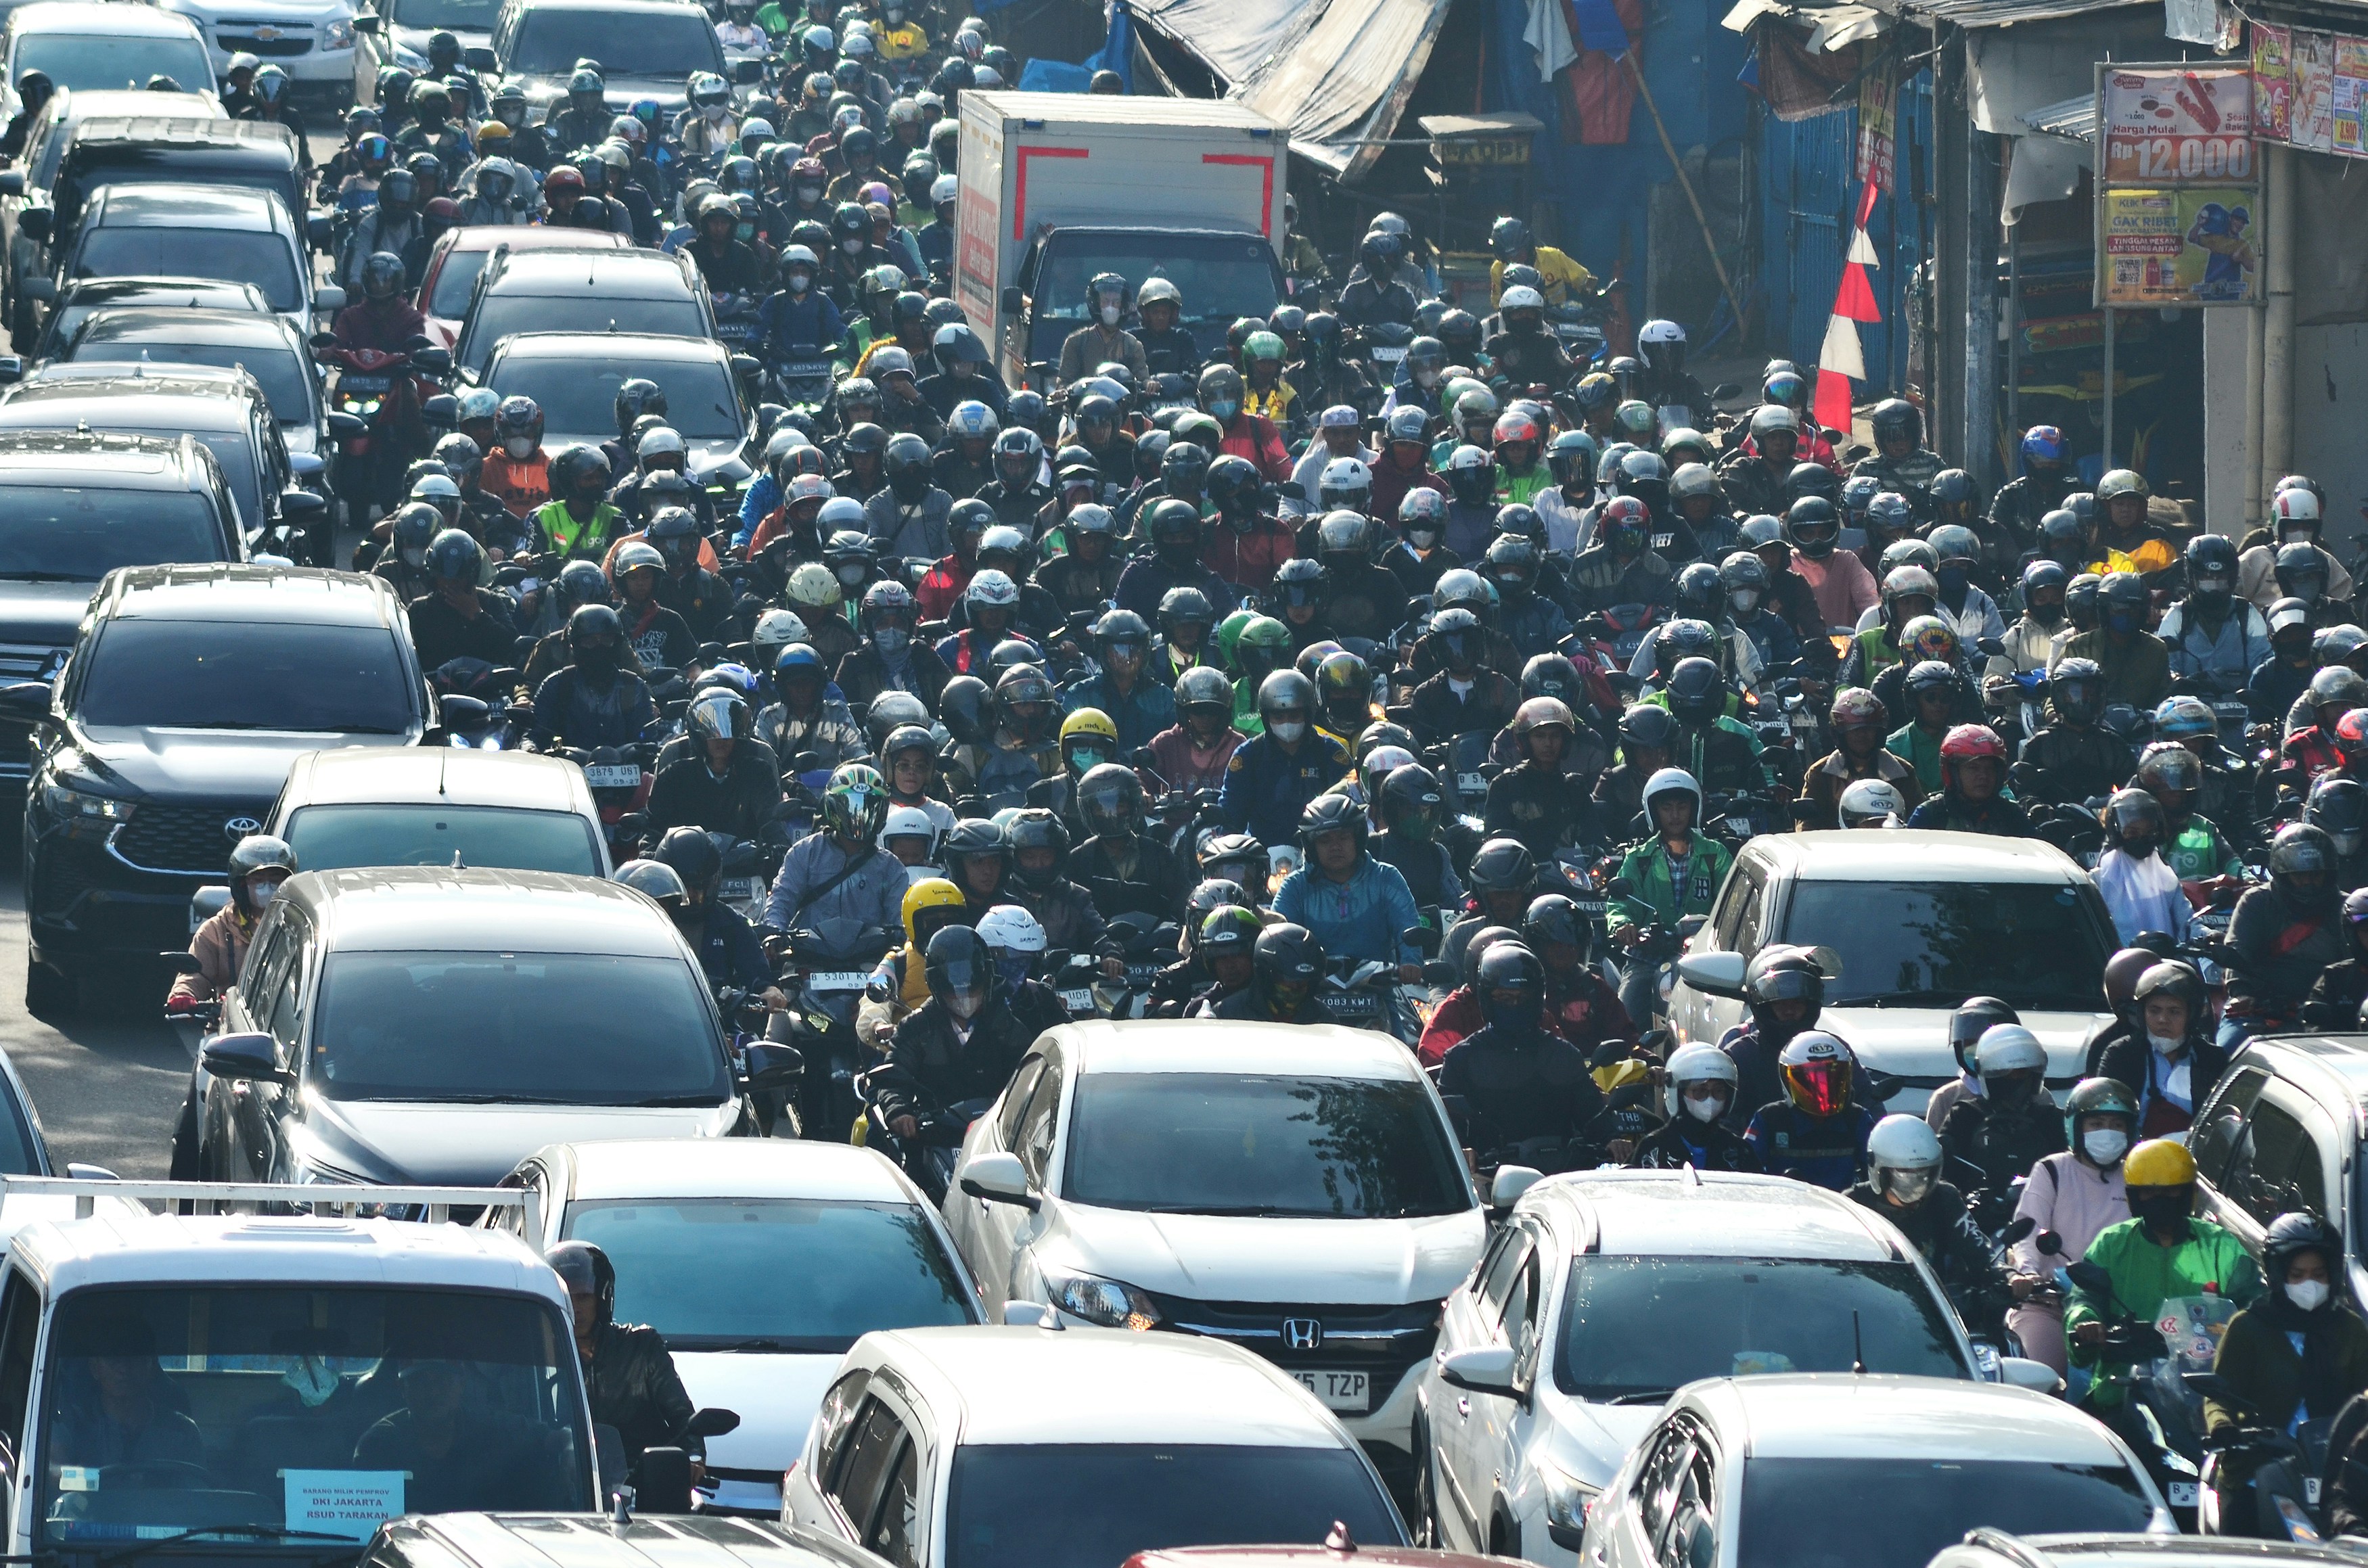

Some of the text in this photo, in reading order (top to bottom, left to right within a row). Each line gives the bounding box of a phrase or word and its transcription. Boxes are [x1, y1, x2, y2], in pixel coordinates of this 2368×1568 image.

[2227, 112, 2250, 121] Sosis
[2112, 124, 2177, 135] Harga Mulai
[2225, 122, 2250, 131] Baka
[2111, 138, 2252, 179] Rp 12.000
[2112, 216, 2178, 227] GAK RIBET
[587, 536, 607, 547] goj
[1237, 712, 1260, 720] Grab
[591, 767, 614, 777] 3879
[1068, 990, 1090, 1000] UDF
[1351, 998, 1372, 1006] KWY
[1618, 1112, 1640, 1122] THB
[1326, 1373, 1352, 1396] TZP
[2173, 1483, 2180, 1494] B
[2308, 1480, 2317, 1494] B
[313, 1498, 383, 1506] DKI JAKARTA
[306, 1511, 389, 1520] RSUD TARAKAN
